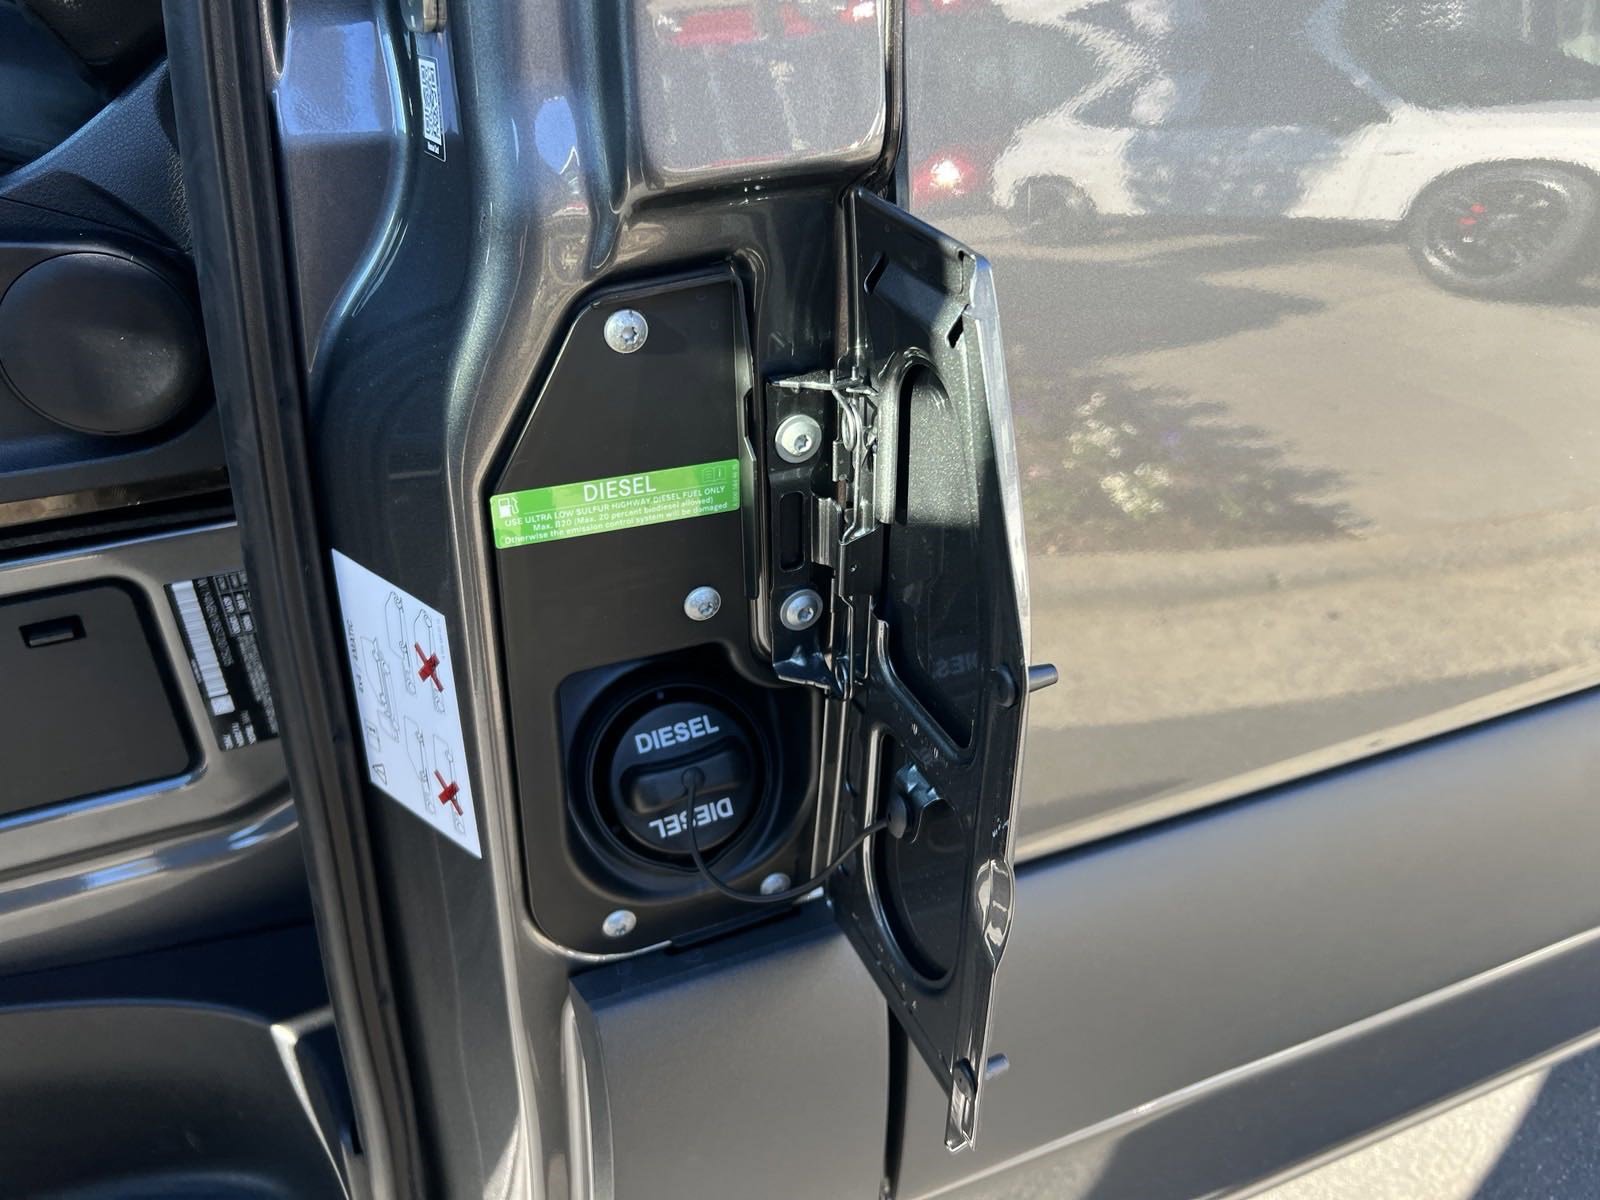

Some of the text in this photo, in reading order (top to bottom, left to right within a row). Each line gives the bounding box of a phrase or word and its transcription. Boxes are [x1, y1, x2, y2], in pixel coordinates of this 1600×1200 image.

[504, 486, 726, 527] USE ULTRA LOW SULFUR HIGHWAY DIESEL FUEL ONLY
[583, 475, 656, 503] DIESEL
[504, 502, 728, 545] Otherwise the emission control system will be damaged
[533, 523, 553, 531] Max.
[599, 512, 609, 521] 20
[611, 508, 642, 520] percent
[644, 501, 680, 513] biodiesel
[681, 496, 714, 507] allowed)
[634, 714, 720, 754] DIESEL
[648, 797, 734, 839] DIESEL
